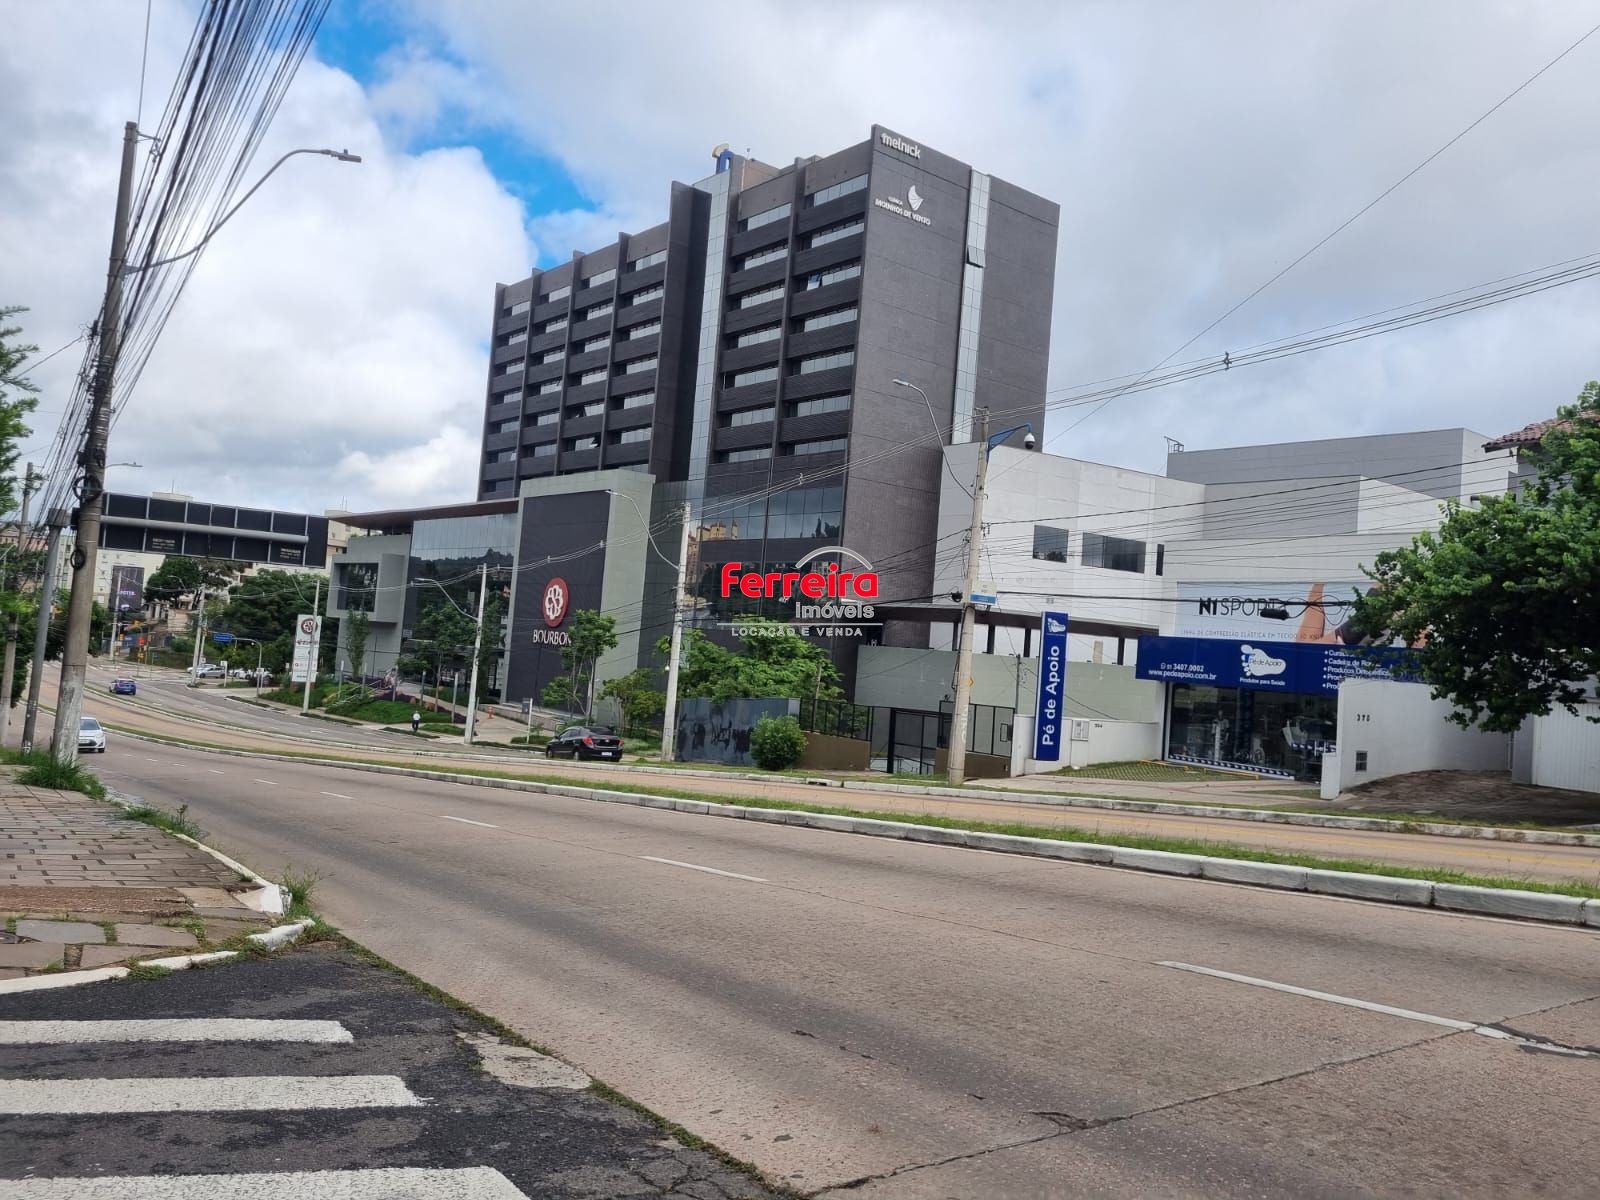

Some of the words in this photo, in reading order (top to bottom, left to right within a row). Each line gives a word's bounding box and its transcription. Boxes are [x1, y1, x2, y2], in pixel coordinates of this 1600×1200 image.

[881, 133, 921, 159] melnick
[903, 210, 912, 218] DE
[1045, 645, 1060, 695] Apoio
[1148, 669, 1217, 681] www.pedeapoio.com.br
[1044, 699, 1057, 719] de
[1042, 724, 1055, 745] Pé
